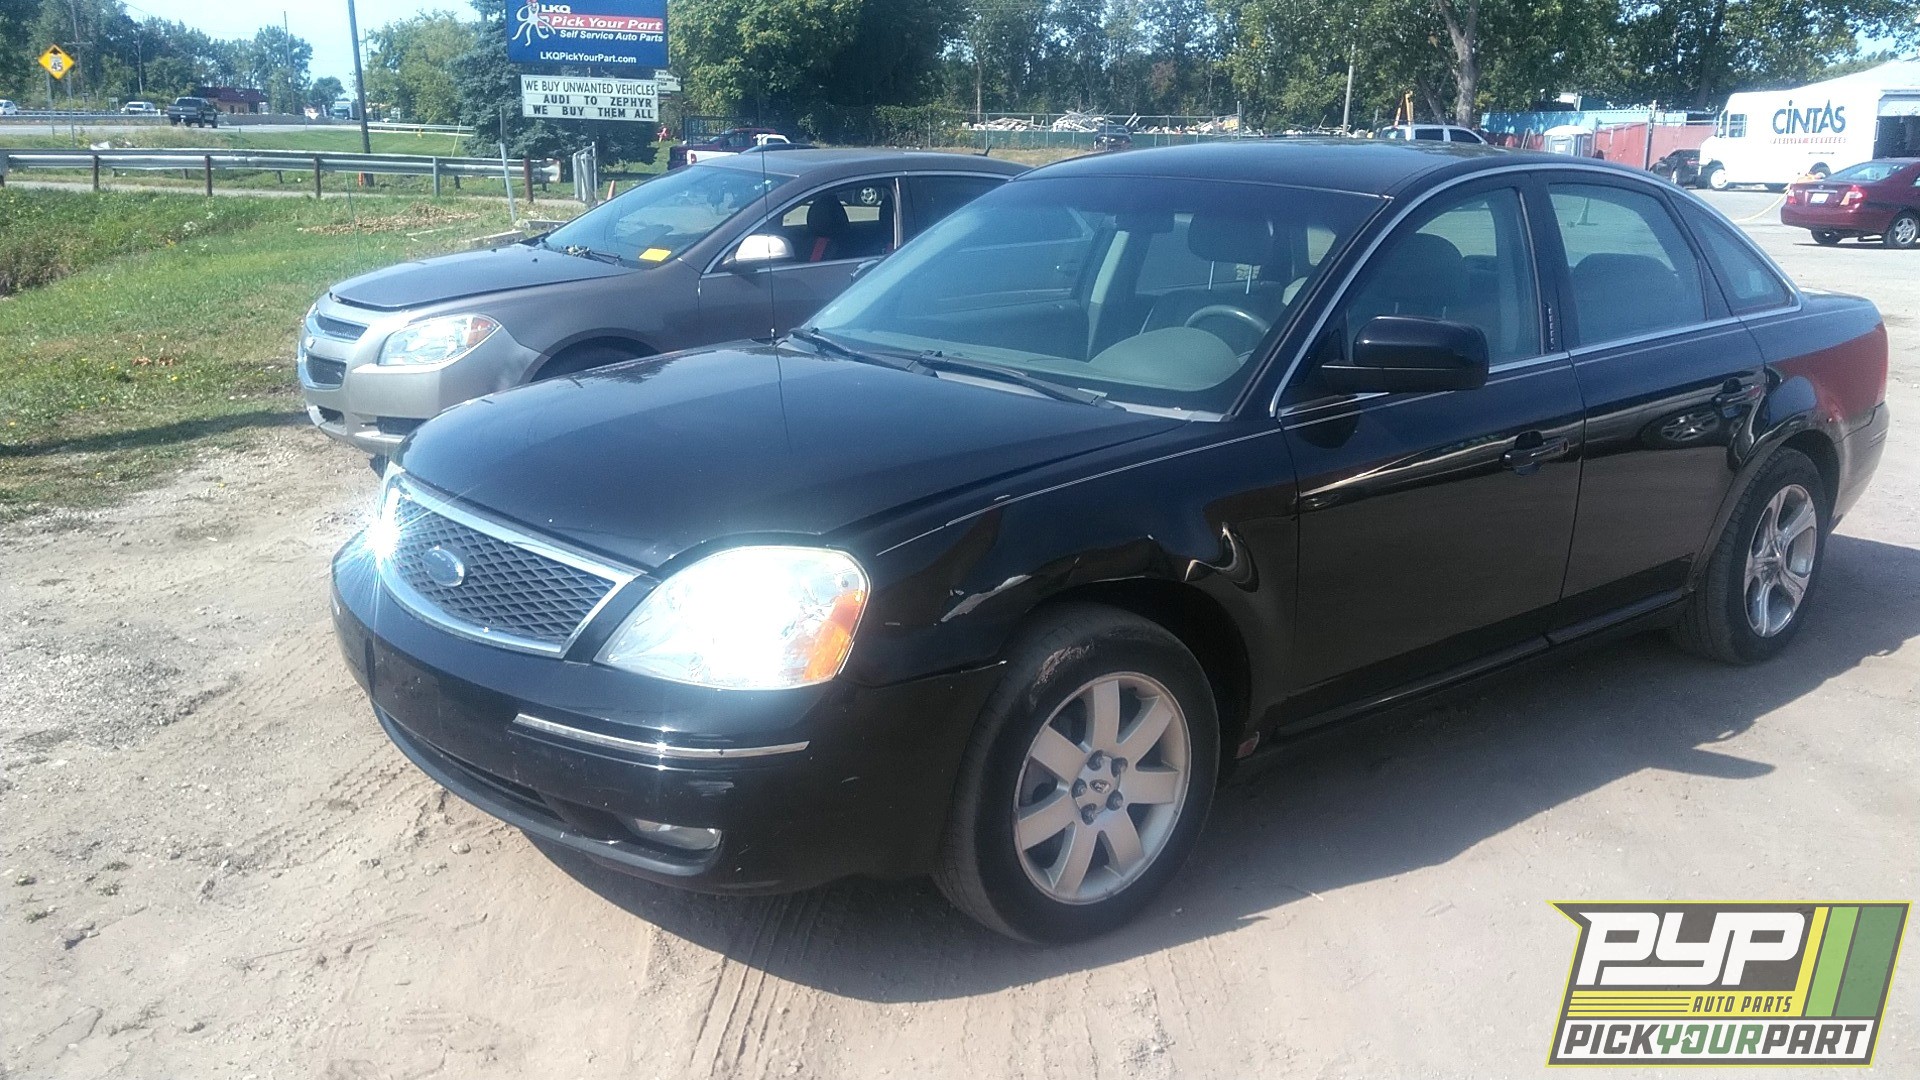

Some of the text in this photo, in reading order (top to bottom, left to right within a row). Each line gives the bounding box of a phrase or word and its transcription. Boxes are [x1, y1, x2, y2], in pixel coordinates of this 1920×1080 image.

[541, 4, 571, 14] LKQ
[551, 15, 661, 31] Pick Your Part
[560, 30, 664, 43] Self Service Auto Parts
[540, 52, 637, 63] LKQPickYourPart.com
[52, 62, 63, 71] 45
[524, 80, 656, 96] WE BUY UNWANTED VEHICLES
[543, 94, 652, 108] AUDI TO ZEPHYR
[533, 105, 654, 119] WE BUY THEM ALL
